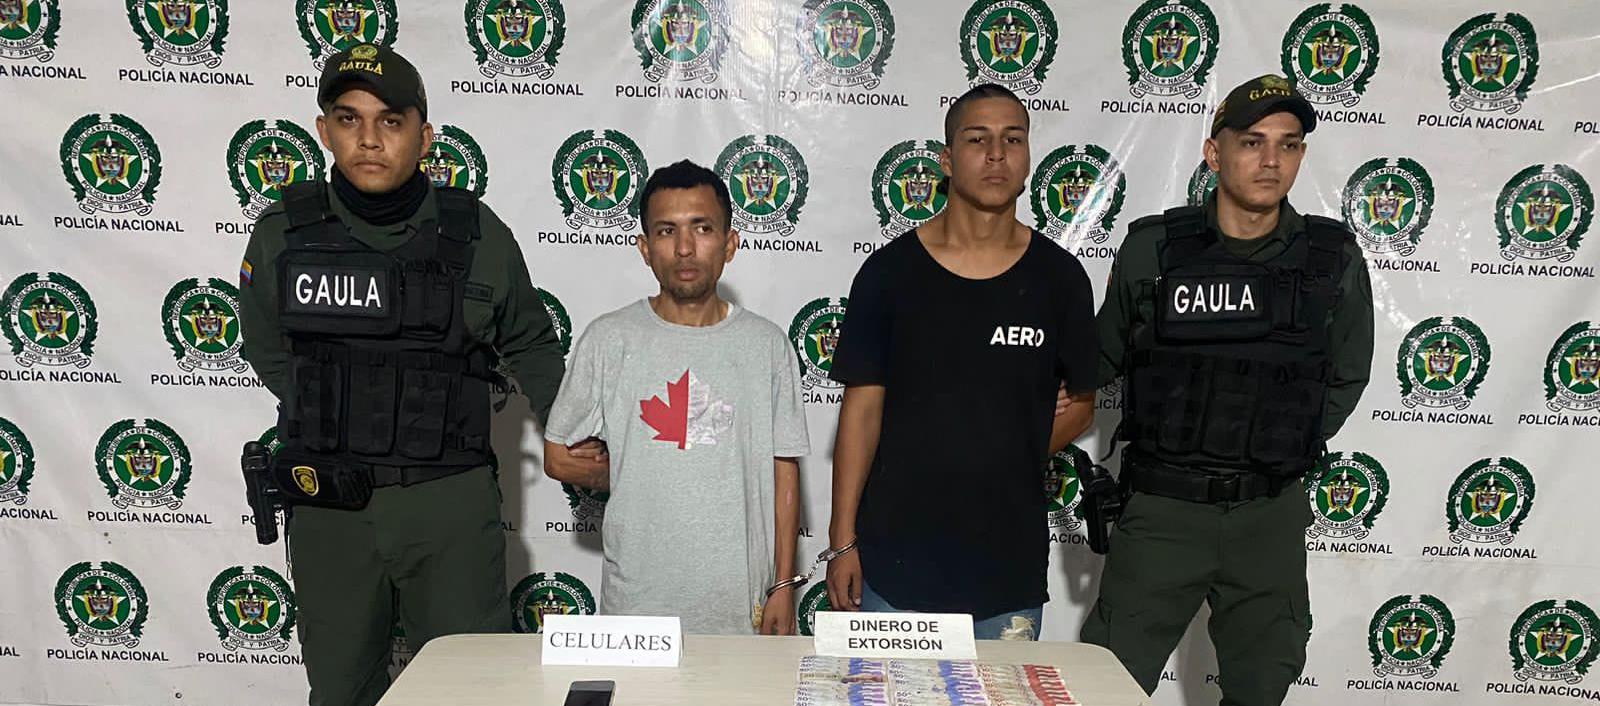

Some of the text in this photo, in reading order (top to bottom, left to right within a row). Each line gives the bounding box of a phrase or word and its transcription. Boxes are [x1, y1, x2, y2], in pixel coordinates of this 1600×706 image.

[12, 66, 86, 79] NACIONAL
[119, 67, 254, 86] POLICÍA NACIONAL
[286, 75, 319, 87] POLI
[451, 79, 584, 96] POLICÍA NACIONAL
[615, 83, 671, 98] POLICÍA
[837, 93, 908, 107] NACIONAL
[1028, 98, 1069, 112] IONAL
[1101, 99, 1154, 113] POLICÍA
[1418, 113, 1545, 131] POLICÍA NACIONAL
[55, 215, 184, 233] POLICÍA NACIONAL
[538, 230, 637, 246] POLICÍA NACIO
[753, 239, 822, 252] NACIONAL
[1076, 247, 1117, 258] ACION
[1374, 259, 1441, 273] NACIONAL
[1471, 262, 1595, 278] POLICÍA NACIONAL
[295, 273, 381, 306] GAULA
[1174, 283, 1255, 313] GAULA
[990, 326, 1044, 347] AERO
[0, 368, 122, 384] OLICÍA NACIONAL
[151, 372, 264, 388] POLICÍA NACION
[1372, 408, 1494, 425] POLICÍA NACIONAL
[1518, 412, 1600, 426] POLICÍA NACI
[0, 508, 58, 520] ACIONAL
[88, 510, 212, 524] POLICÍA NACIONAL
[545, 519, 597, 532] POLICÍA
[1050, 533, 1089, 545] ACION
[1330, 543, 1393, 554] NACIONAL
[1422, 545, 1537, 559] POLICÍA NACIONAL
[849, 619, 939, 633] DINERO DE
[549, 630, 672, 652] CELULARES
[848, 636, 943, 651] EXTORSIÓN
[47, 648, 168, 662] POLICÍA NACIONAL
[198, 652, 303, 665] POLICÍA NACION
[1347, 679, 1460, 692] POLICÍA NACIONAL
[1487, 683, 1600, 700] POLICÍA NACIONA
